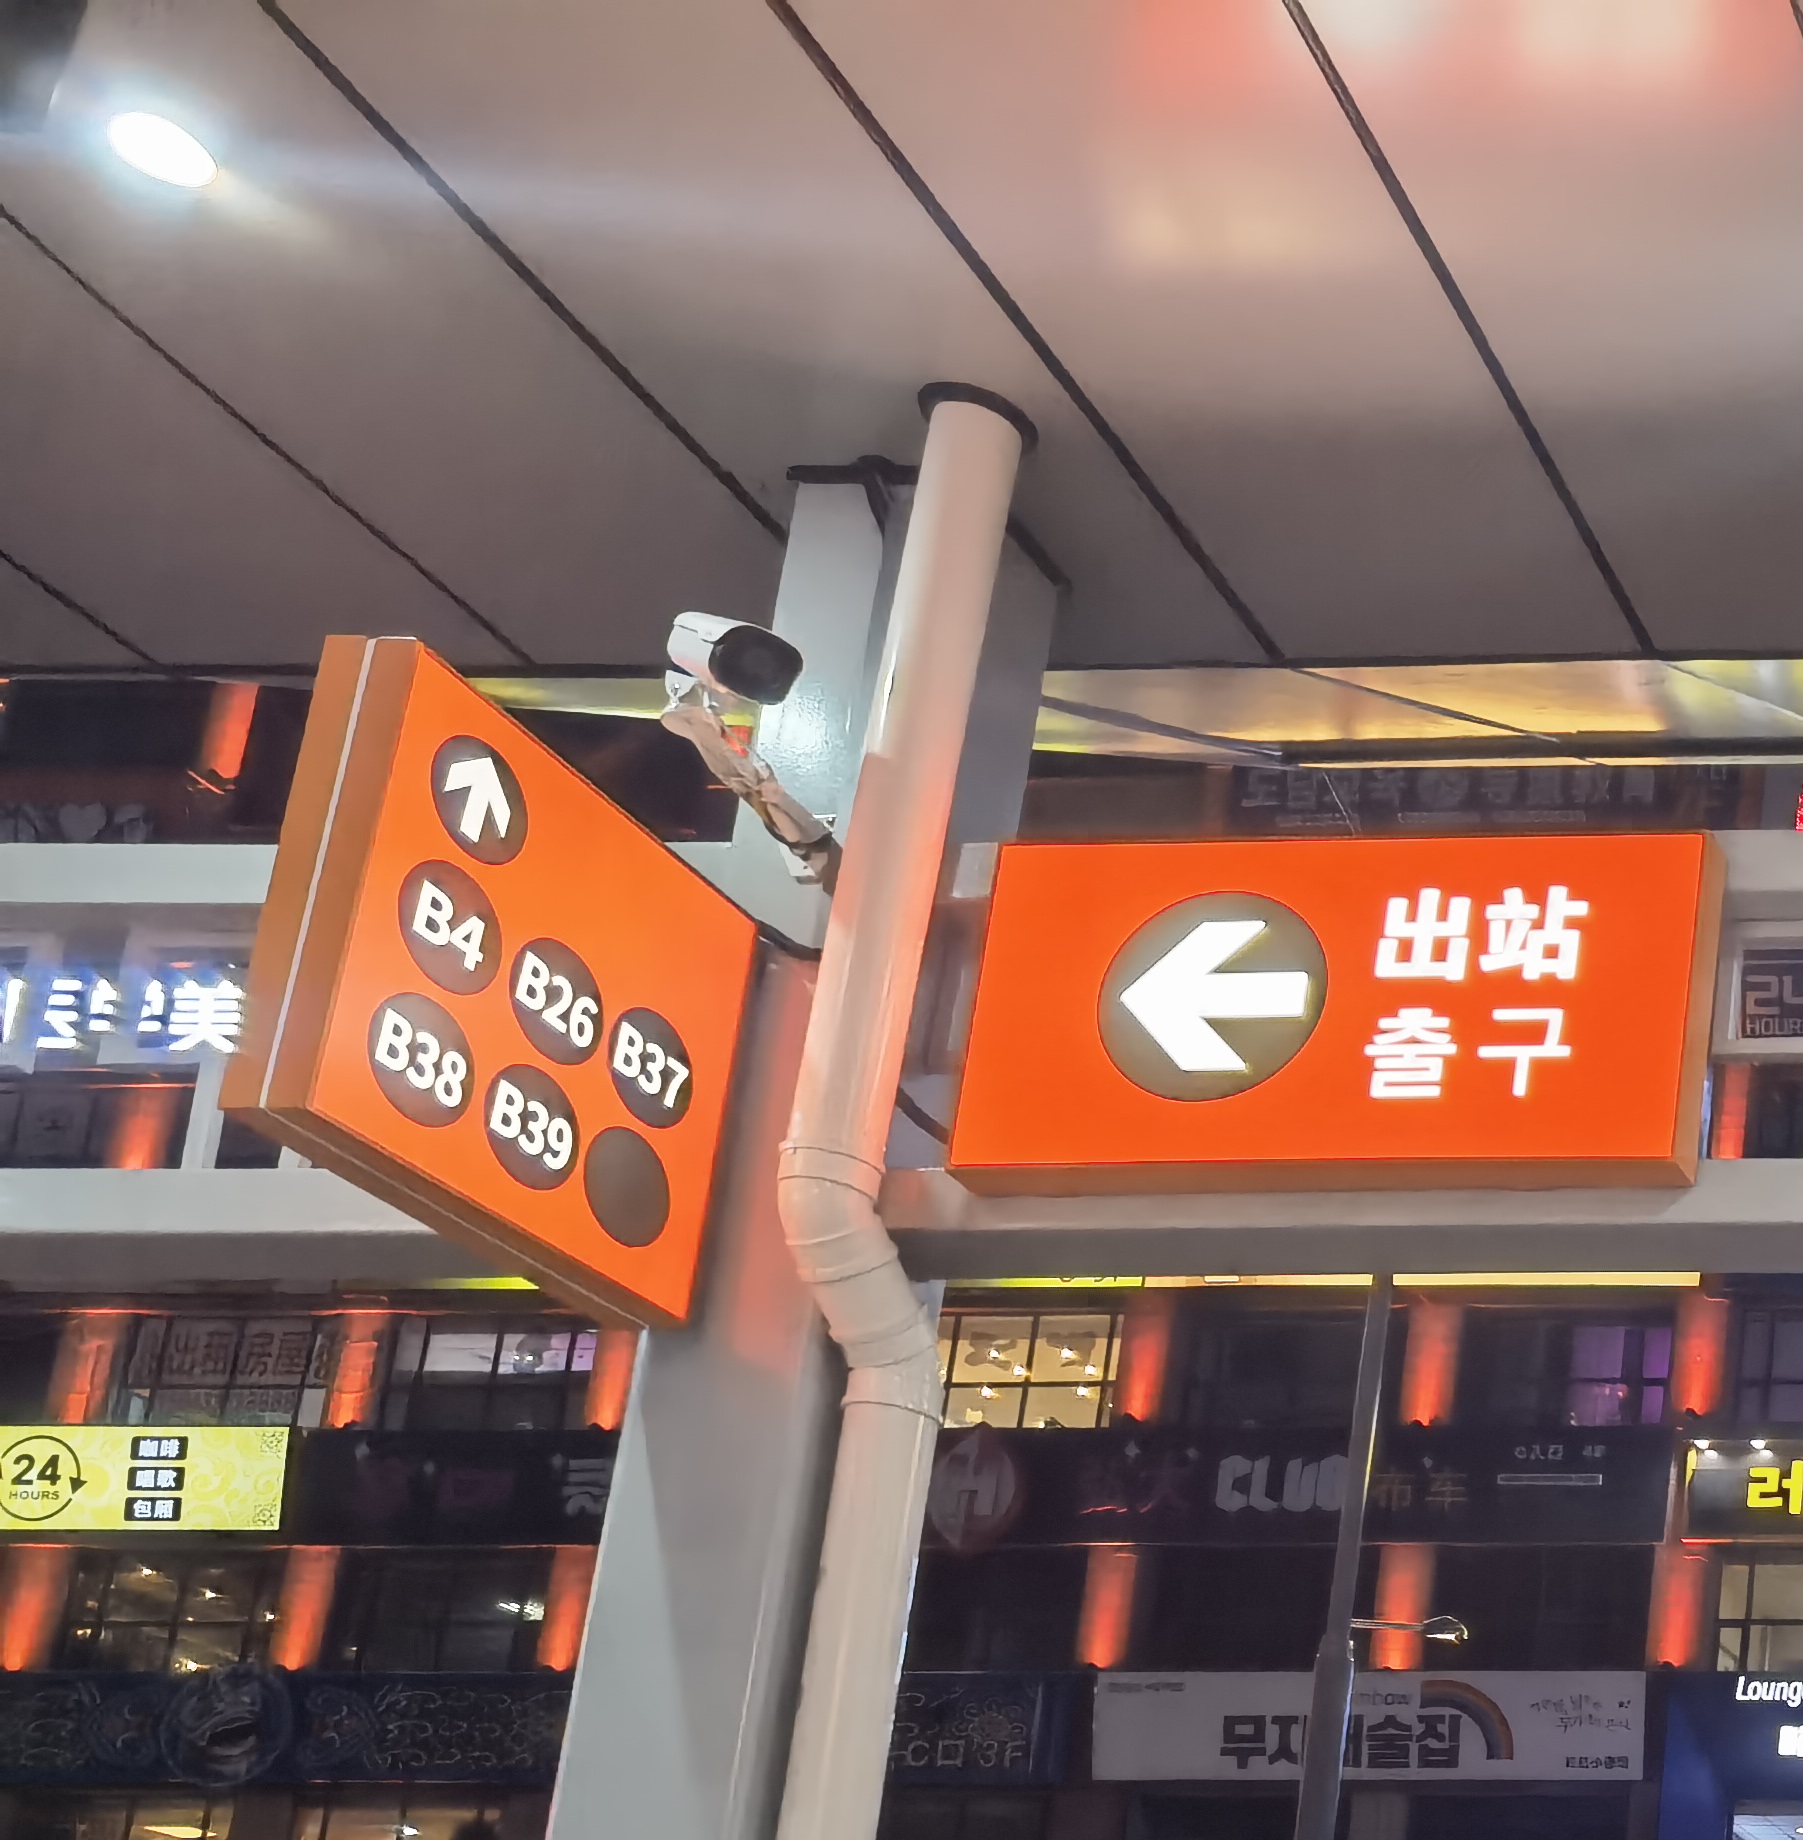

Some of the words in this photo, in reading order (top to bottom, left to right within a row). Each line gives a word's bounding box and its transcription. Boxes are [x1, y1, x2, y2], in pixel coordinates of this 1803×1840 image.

[413, 880, 485, 975] B4
[1375, 886, 1589, 981] 出站
[515, 950, 599, 1049] B26
[376, 1013, 467, 1101] B38
[613, 1031, 688, 1110] B37
[1364, 1007, 1572, 1099] 출구
[490, 1085, 573, 1170] B39
[8, 1490, 60, 1502] HOURS
[12, 1454, 62, 1486] 24
[1218, 1714, 1462, 1769] 무지술집
